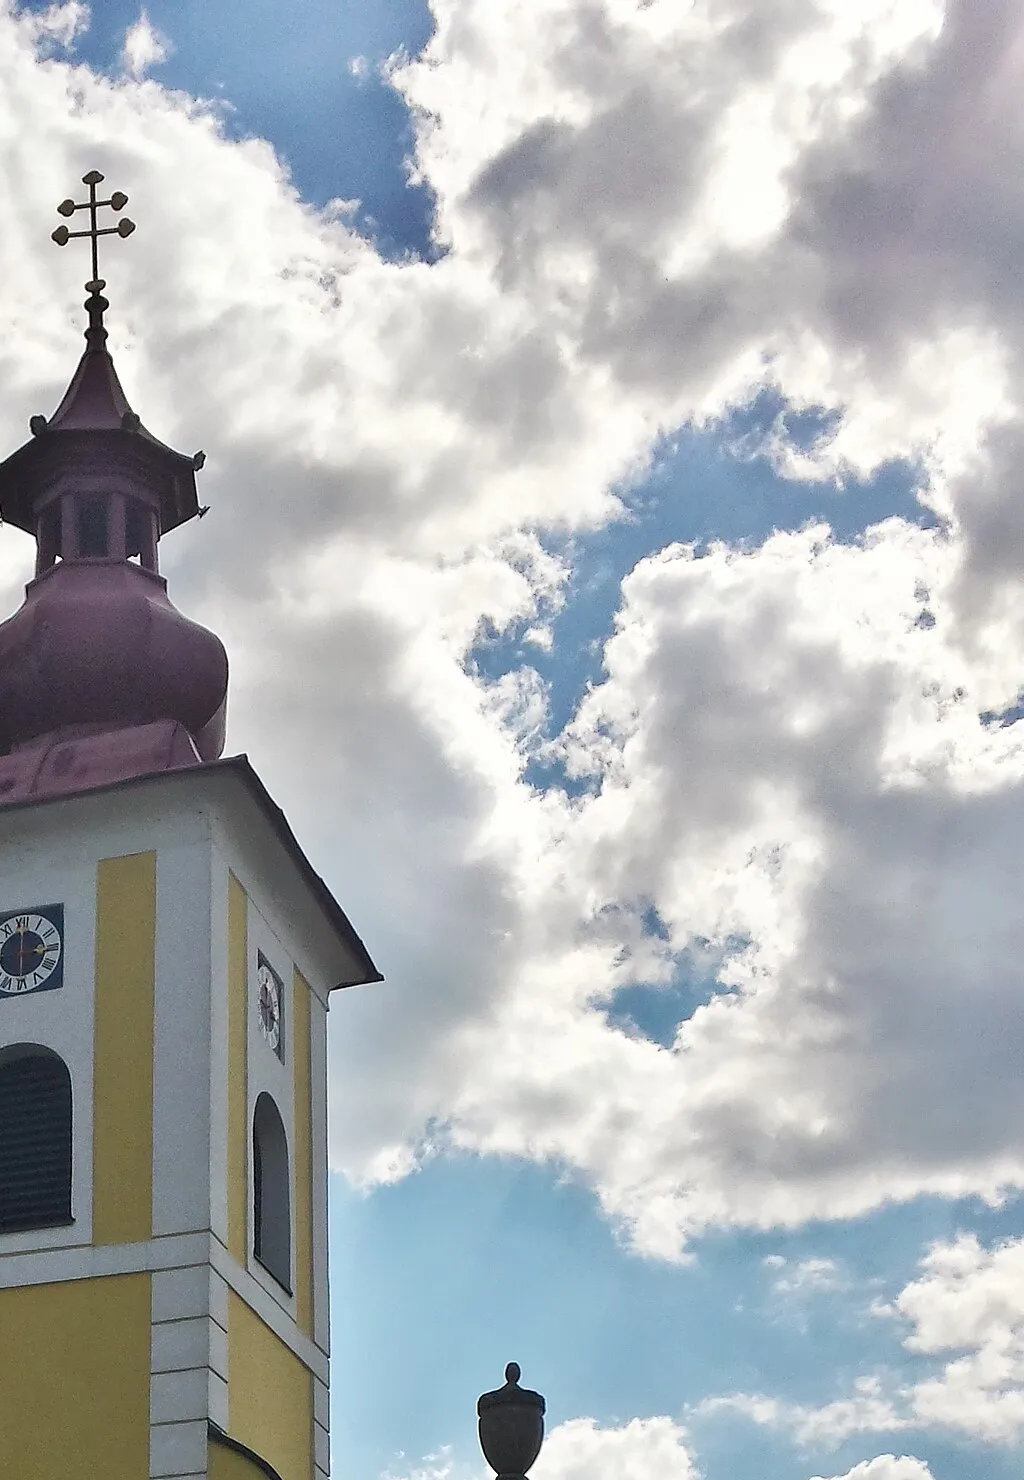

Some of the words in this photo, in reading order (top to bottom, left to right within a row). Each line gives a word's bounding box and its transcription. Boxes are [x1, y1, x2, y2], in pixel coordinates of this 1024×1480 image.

[0, 923, 13, 938] XI
[35, 918, 43, 931] I
[42, 927, 55, 938] II
[46, 943, 59, 952] III
[33, 972, 44, 984] V
